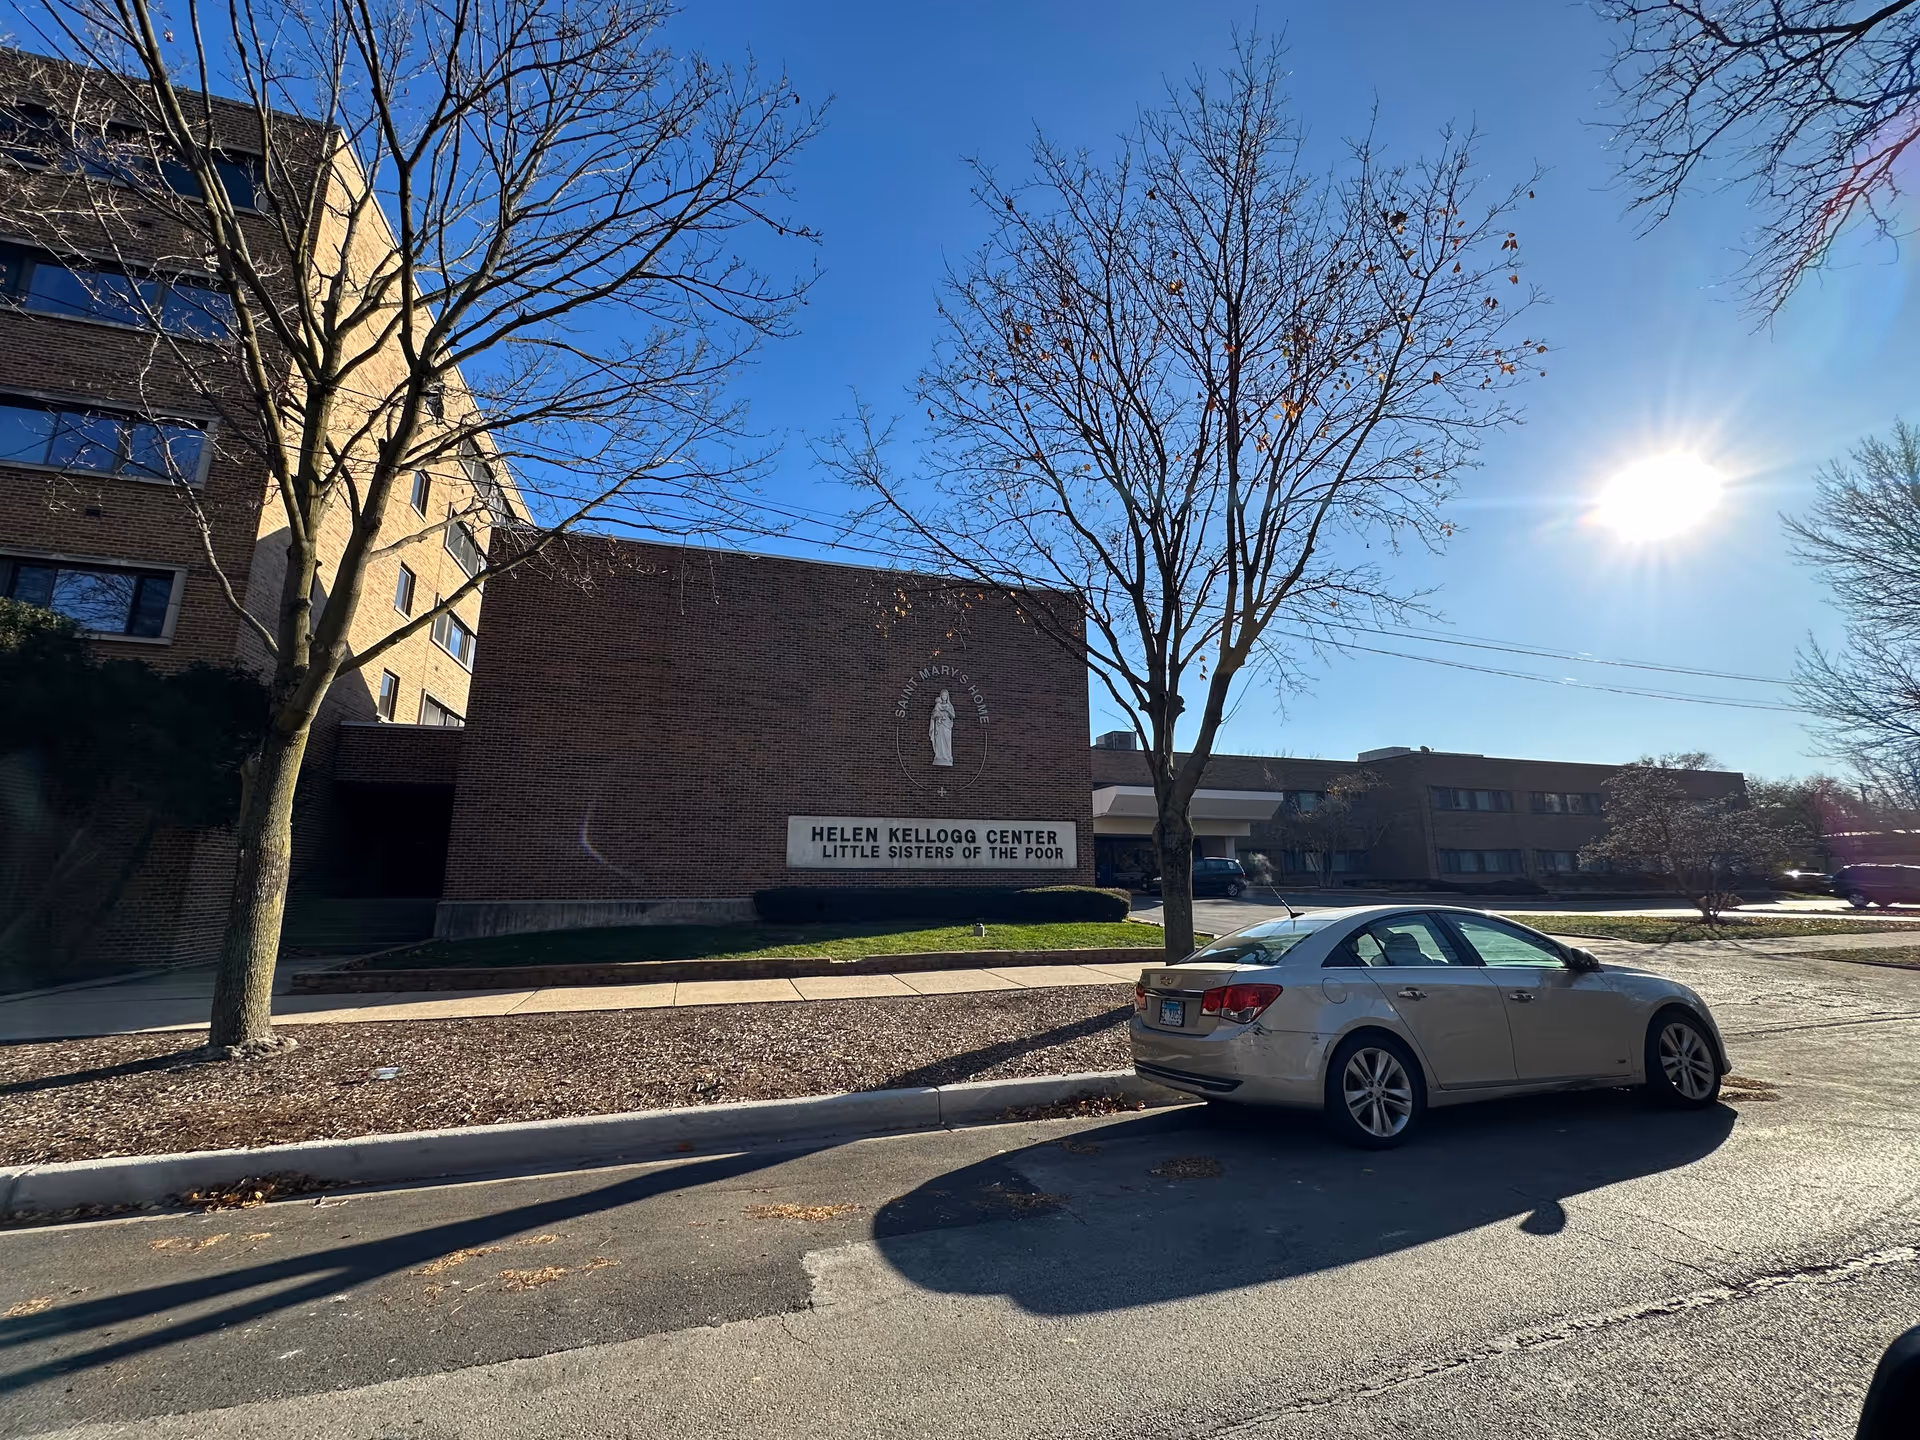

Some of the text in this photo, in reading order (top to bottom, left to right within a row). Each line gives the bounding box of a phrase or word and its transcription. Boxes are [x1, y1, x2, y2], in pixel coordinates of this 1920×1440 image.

[895, 665, 990, 724] SAINT MARY'S HOME
[811, 826, 1057, 845] HELEN KELLOGG CENTER
[822, 845, 1064, 860] LITTLE SISTERS OF THE POOR
